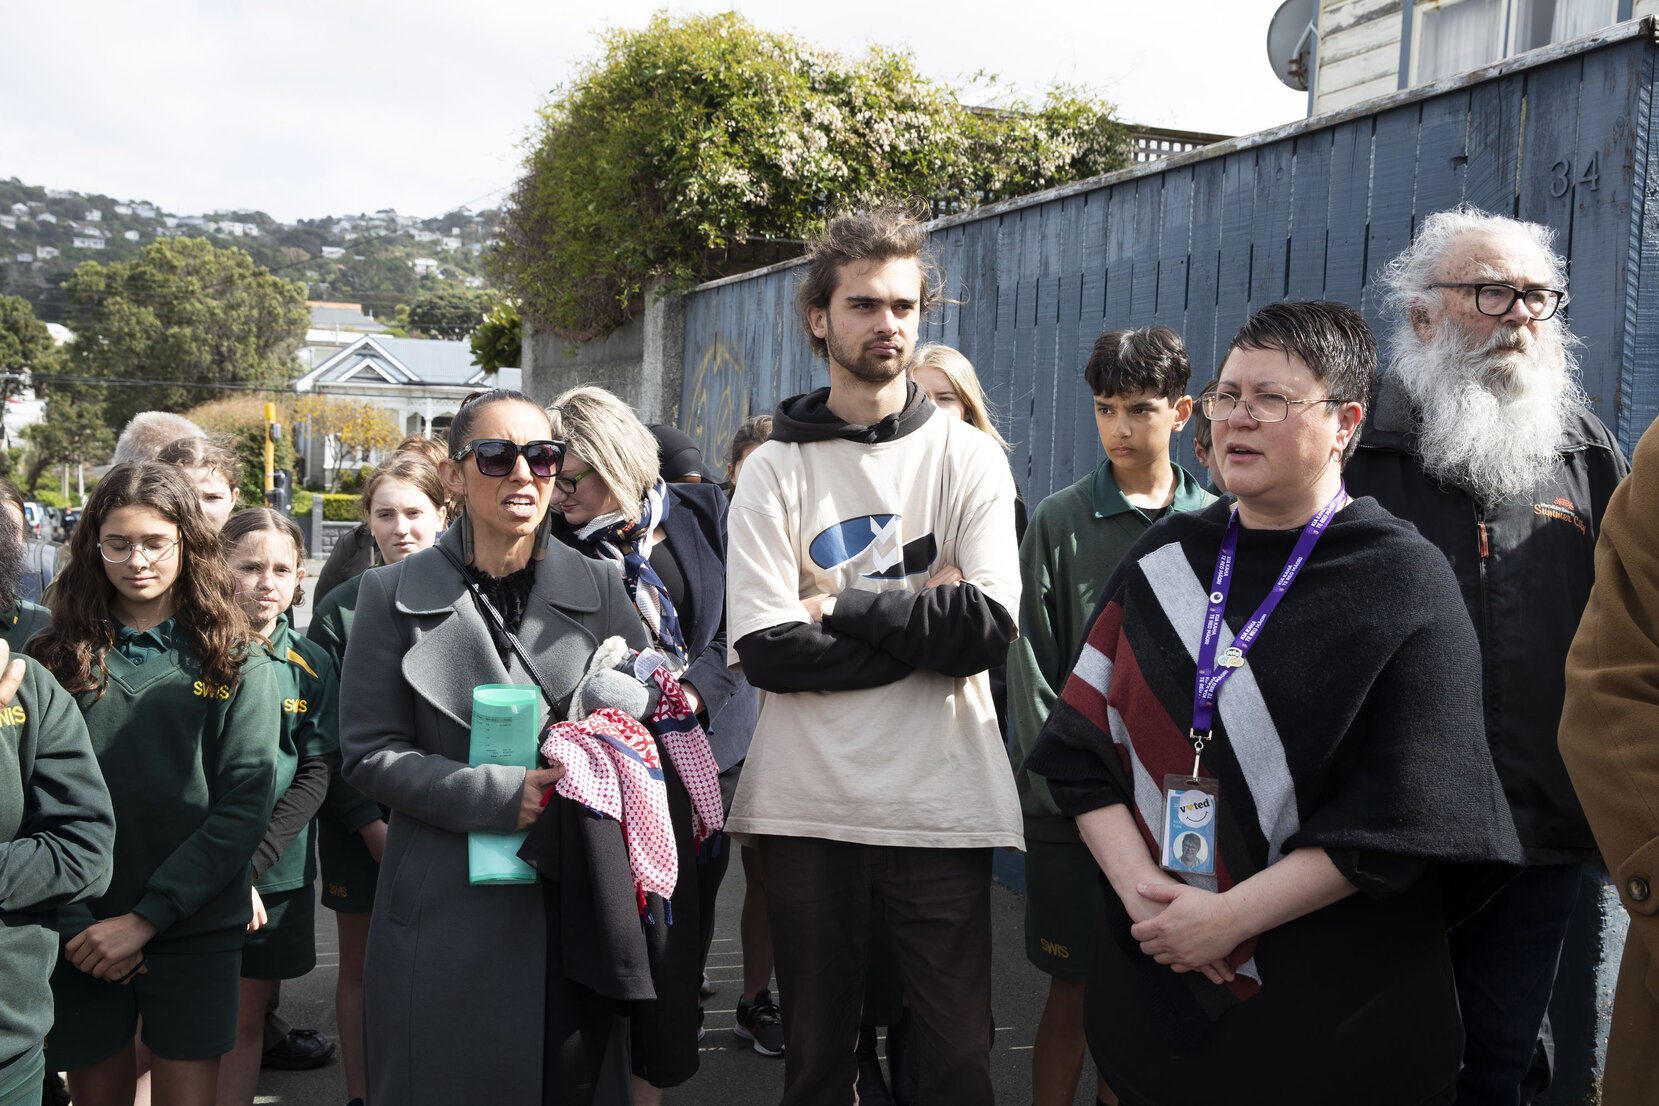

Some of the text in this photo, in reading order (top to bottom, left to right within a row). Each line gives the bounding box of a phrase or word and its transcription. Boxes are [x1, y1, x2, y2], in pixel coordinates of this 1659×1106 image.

[1551, 150, 1600, 198] 34
[1310, 519, 1318, 527] KIA
[1319, 515, 1328, 523] REO
[1277, 565, 1293, 585] KIA KAHA
[1285, 572, 1294, 580] REO
[1240, 621, 1257, 640] KIA KAHA
[1249, 628, 1258, 636] REO
[283, 698, 308, 713] SWIS
[1040, 938, 1070, 958] SWIS
